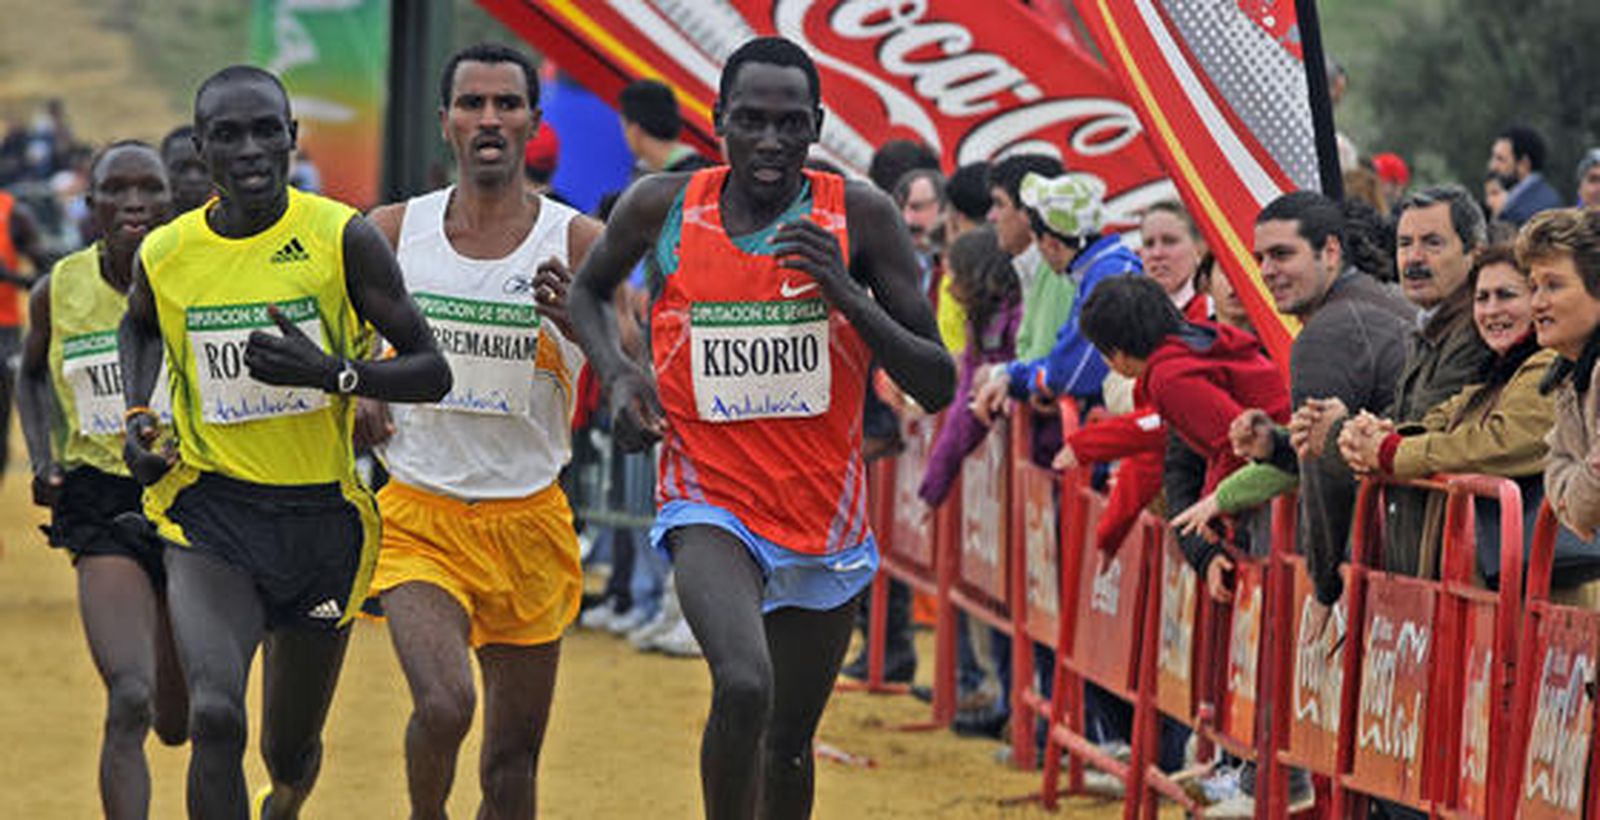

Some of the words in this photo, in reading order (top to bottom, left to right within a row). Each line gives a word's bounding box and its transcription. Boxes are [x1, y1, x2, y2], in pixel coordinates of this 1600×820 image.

[765, 305, 781, 320] DE
[204, 340, 247, 379] RO
[703, 333, 819, 377] KISORIO
